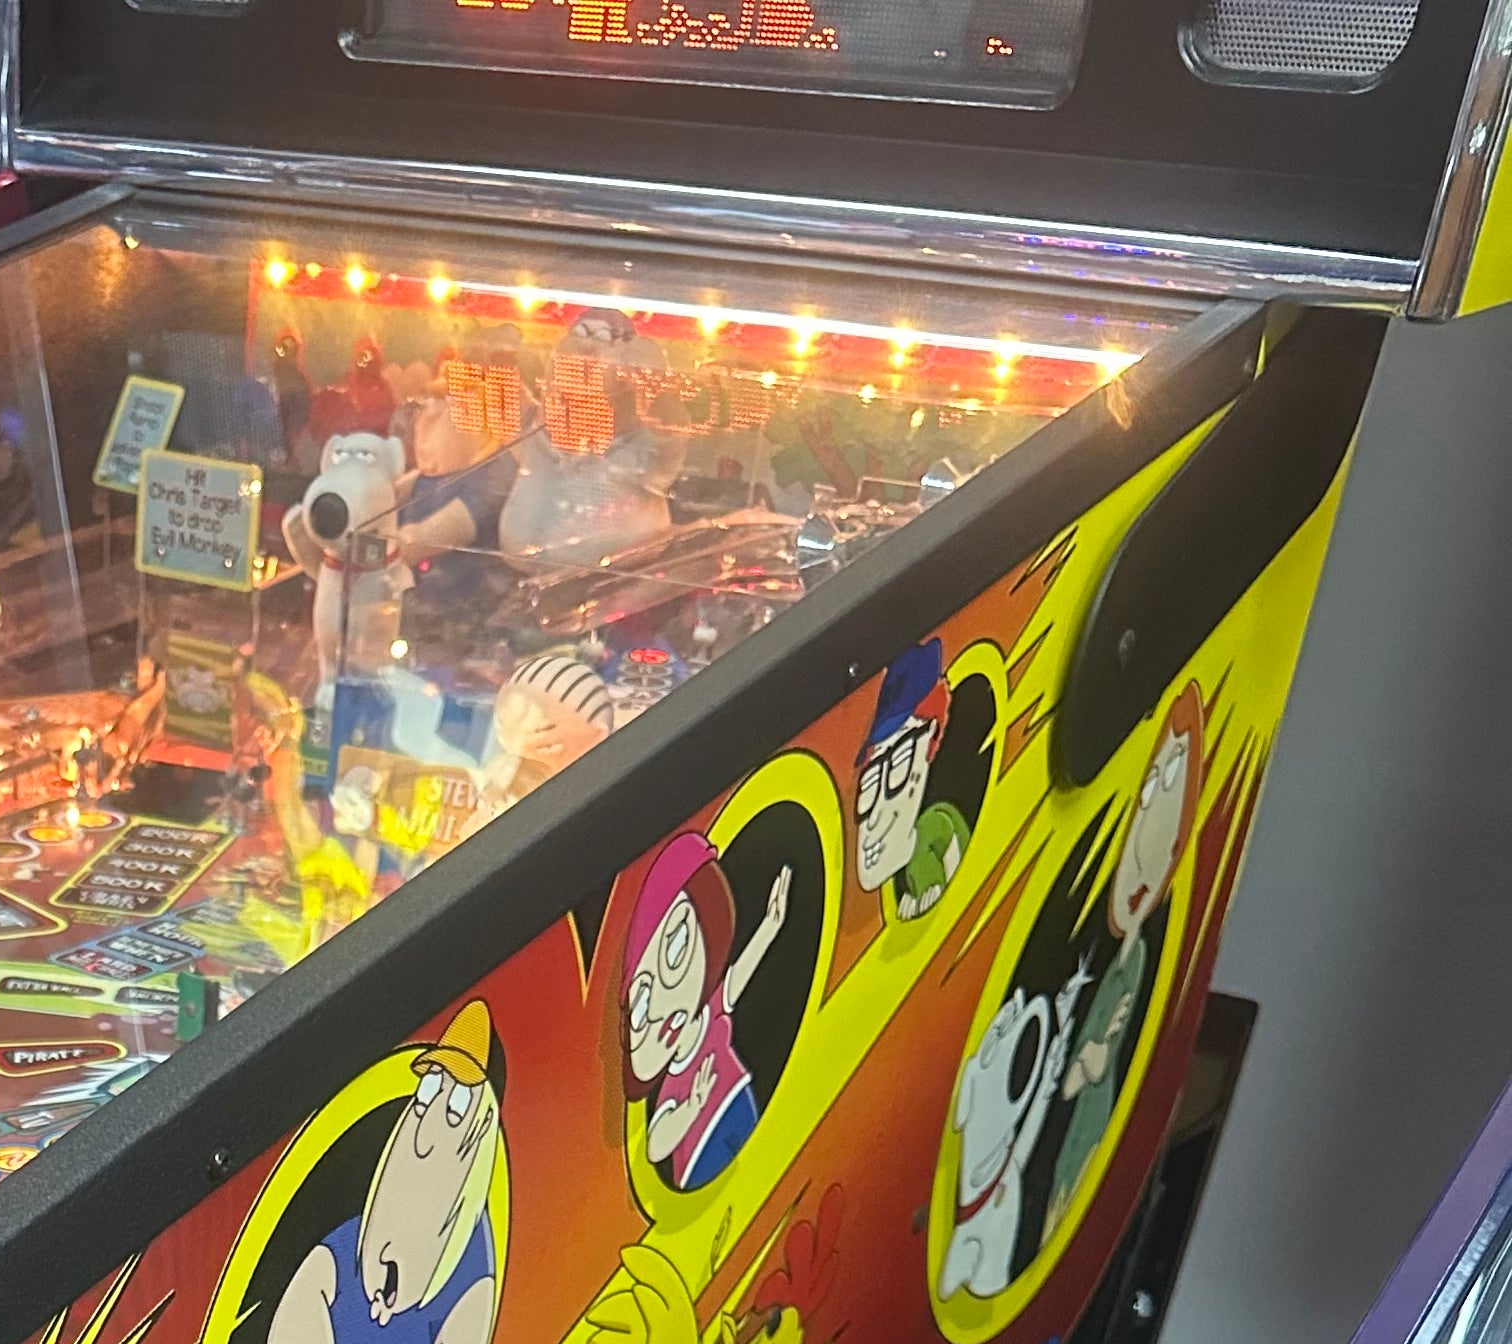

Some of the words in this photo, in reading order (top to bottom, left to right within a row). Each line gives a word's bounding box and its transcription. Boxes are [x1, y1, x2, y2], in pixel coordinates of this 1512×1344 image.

[148, 481, 186, 506] Chris
[187, 510, 223, 534] drop
[179, 530, 242, 560] Monkey
